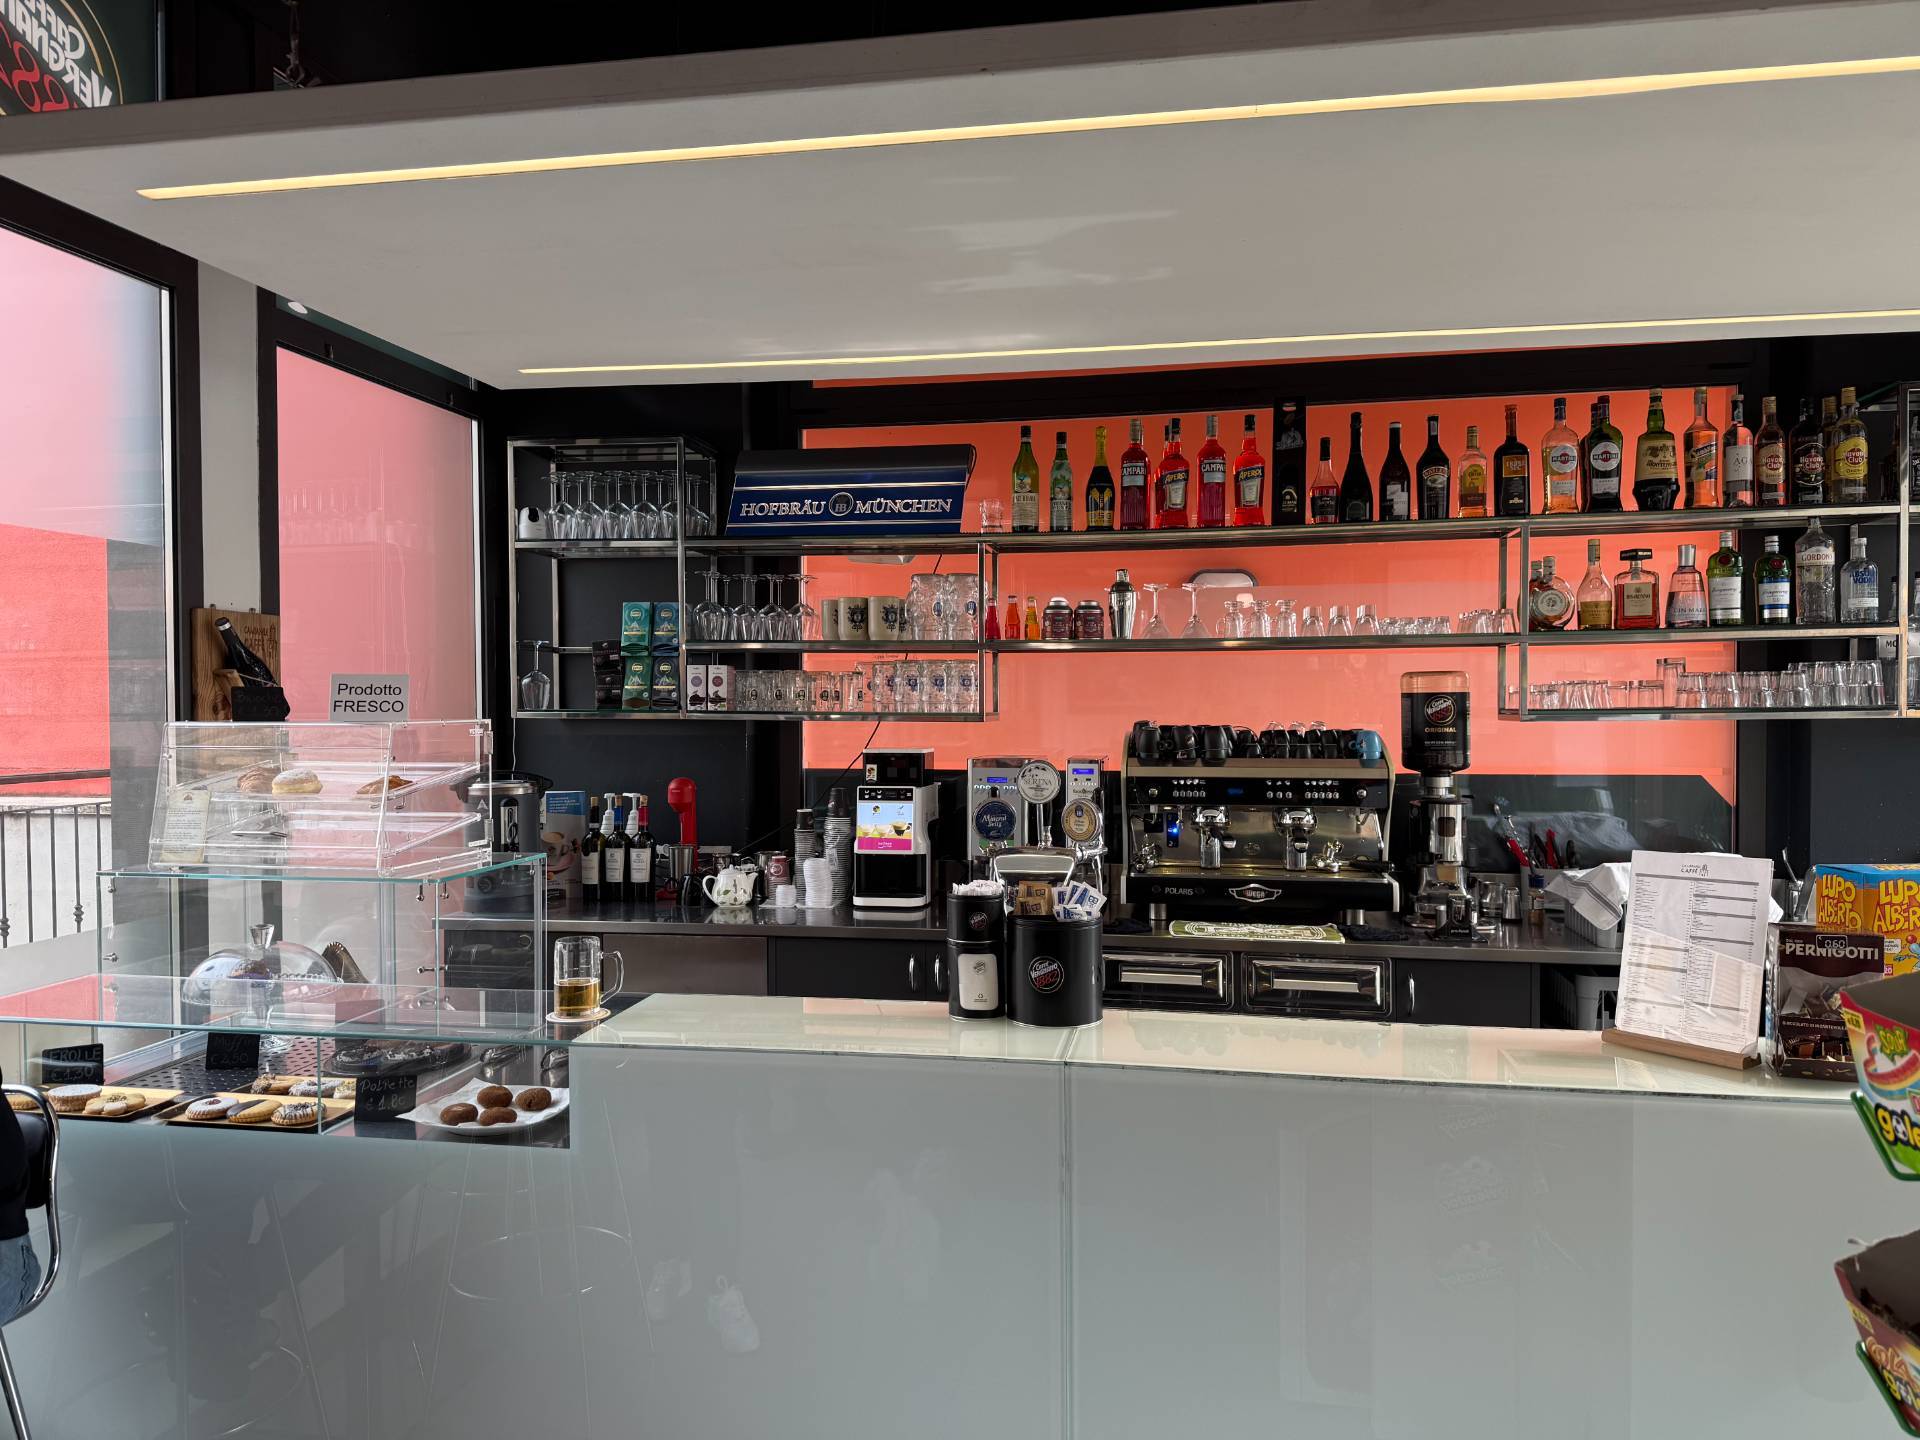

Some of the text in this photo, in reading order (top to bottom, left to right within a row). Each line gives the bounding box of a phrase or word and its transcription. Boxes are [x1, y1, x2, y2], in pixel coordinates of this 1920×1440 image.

[740, 499, 826, 517] HOFBRÄU
[854, 497, 953, 517] MÜNCHEN
[337, 683, 402, 696] Prodotto
[333, 700, 404, 713] FRESCO
[1165, 887, 1194, 896] POLARIS
[1246, 890, 1266, 898] WEGA
[1822, 873, 1857, 902] LUPO
[1818, 897, 1862, 933] ALBERTO
[1872, 903, 1920, 934] ALBER
[1785, 942, 1880, 960] PERNIGOTTI
